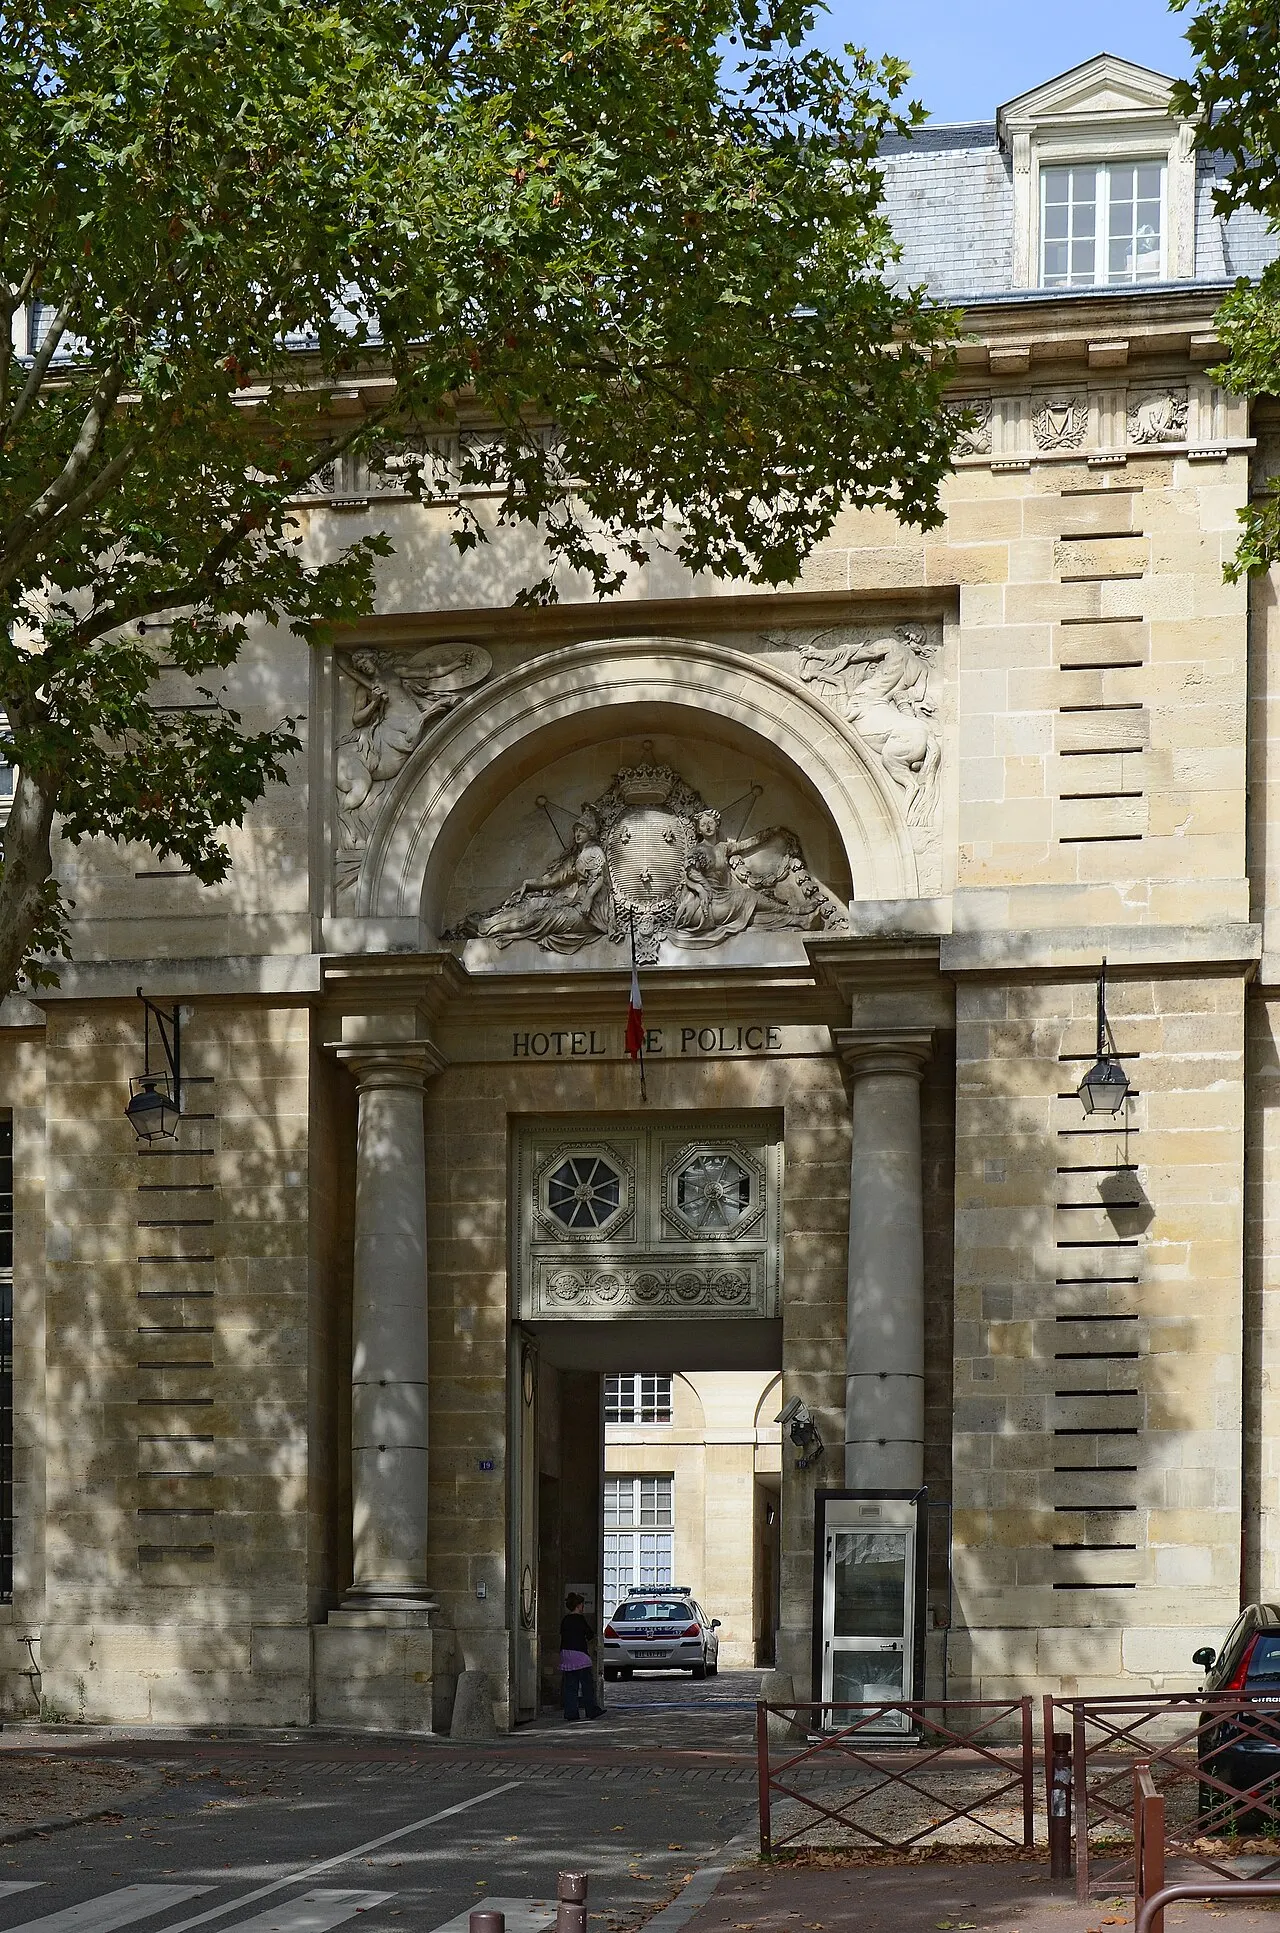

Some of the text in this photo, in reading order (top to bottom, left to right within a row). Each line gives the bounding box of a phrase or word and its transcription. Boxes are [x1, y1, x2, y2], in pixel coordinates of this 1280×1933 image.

[513, 1026, 783, 1056] HOTEL E POLICE
